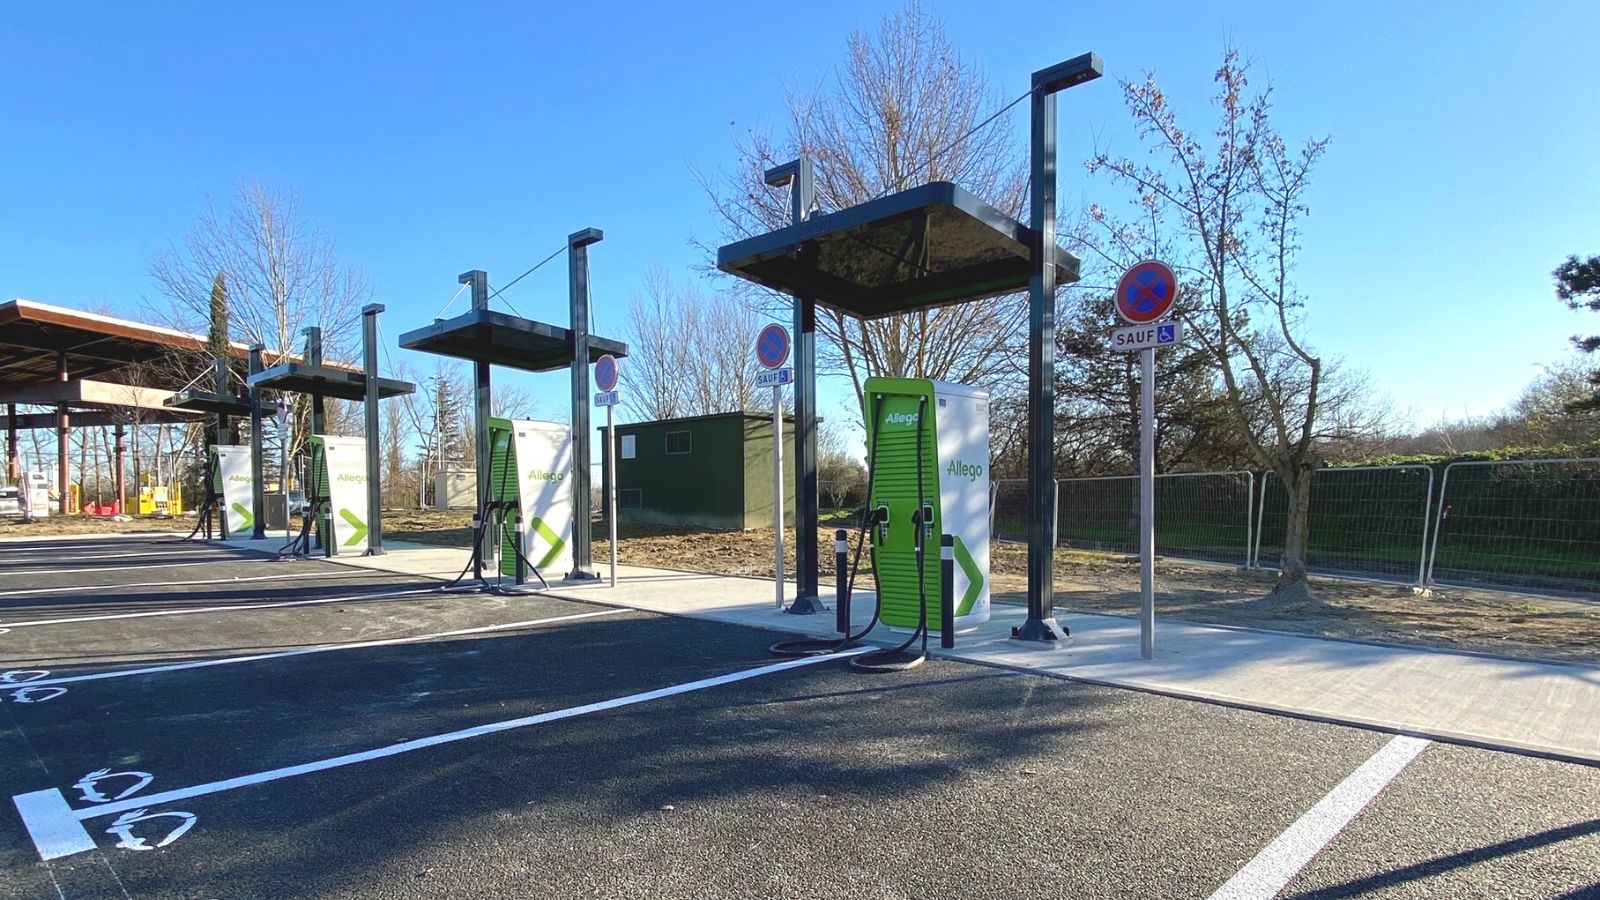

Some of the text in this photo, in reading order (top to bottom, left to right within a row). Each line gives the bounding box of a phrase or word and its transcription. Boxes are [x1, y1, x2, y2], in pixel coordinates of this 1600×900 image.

[1116, 330, 1155, 346] SAUF
[757, 373, 778, 385] SAUF
[885, 412, 919, 425] Allego
[528, 469, 564, 484] Allego
[947, 459, 983, 482] Allego
